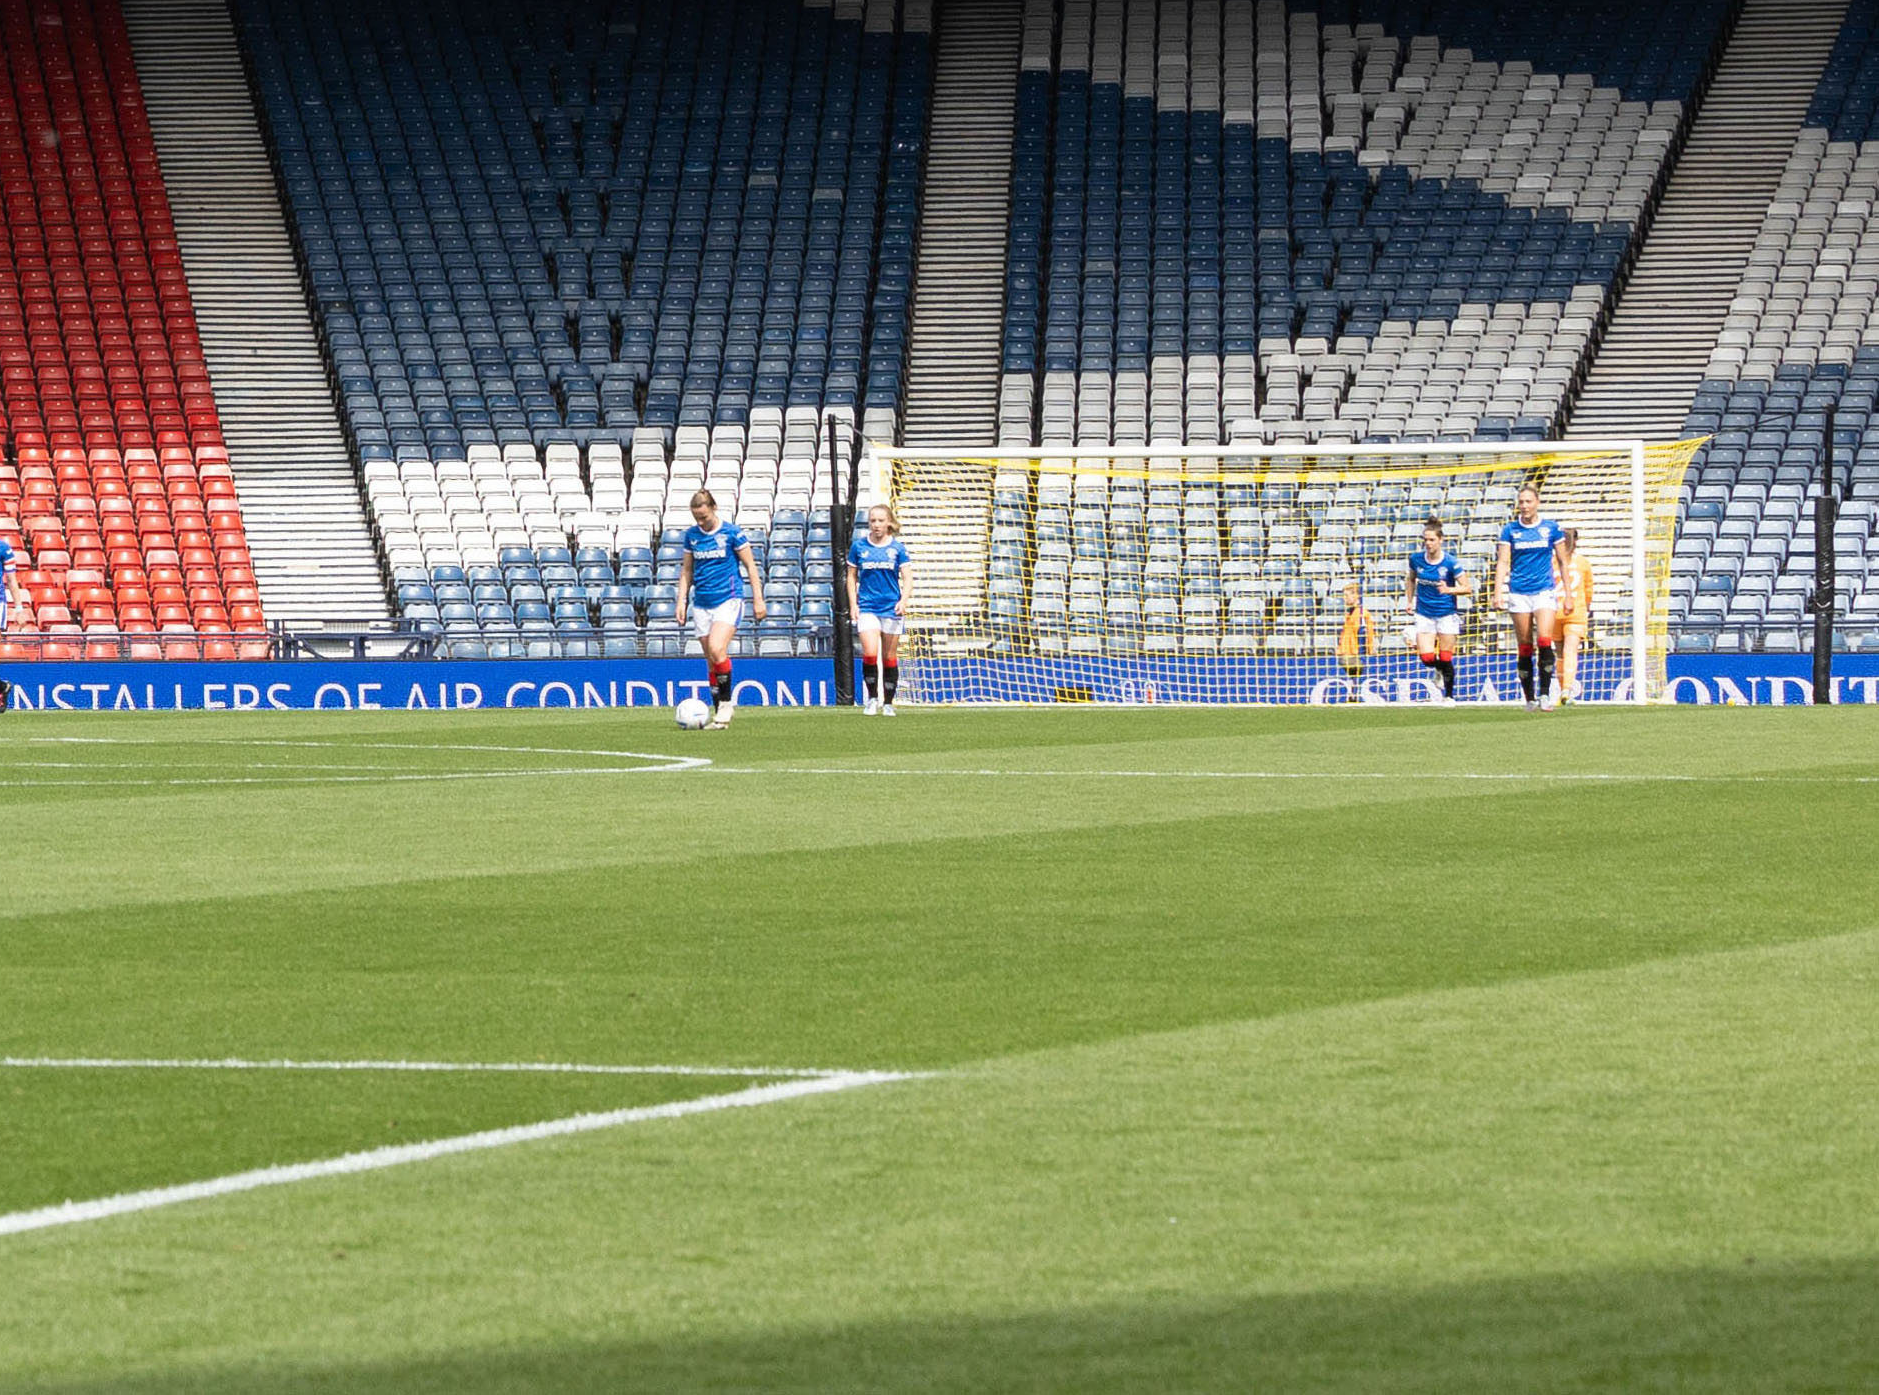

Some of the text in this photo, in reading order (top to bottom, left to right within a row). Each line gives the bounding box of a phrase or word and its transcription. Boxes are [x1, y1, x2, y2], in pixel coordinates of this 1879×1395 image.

[12, 684, 291, 711] NSTALLERS
[314, 683, 382, 710] OF
[407, 683, 483, 710] AIR
